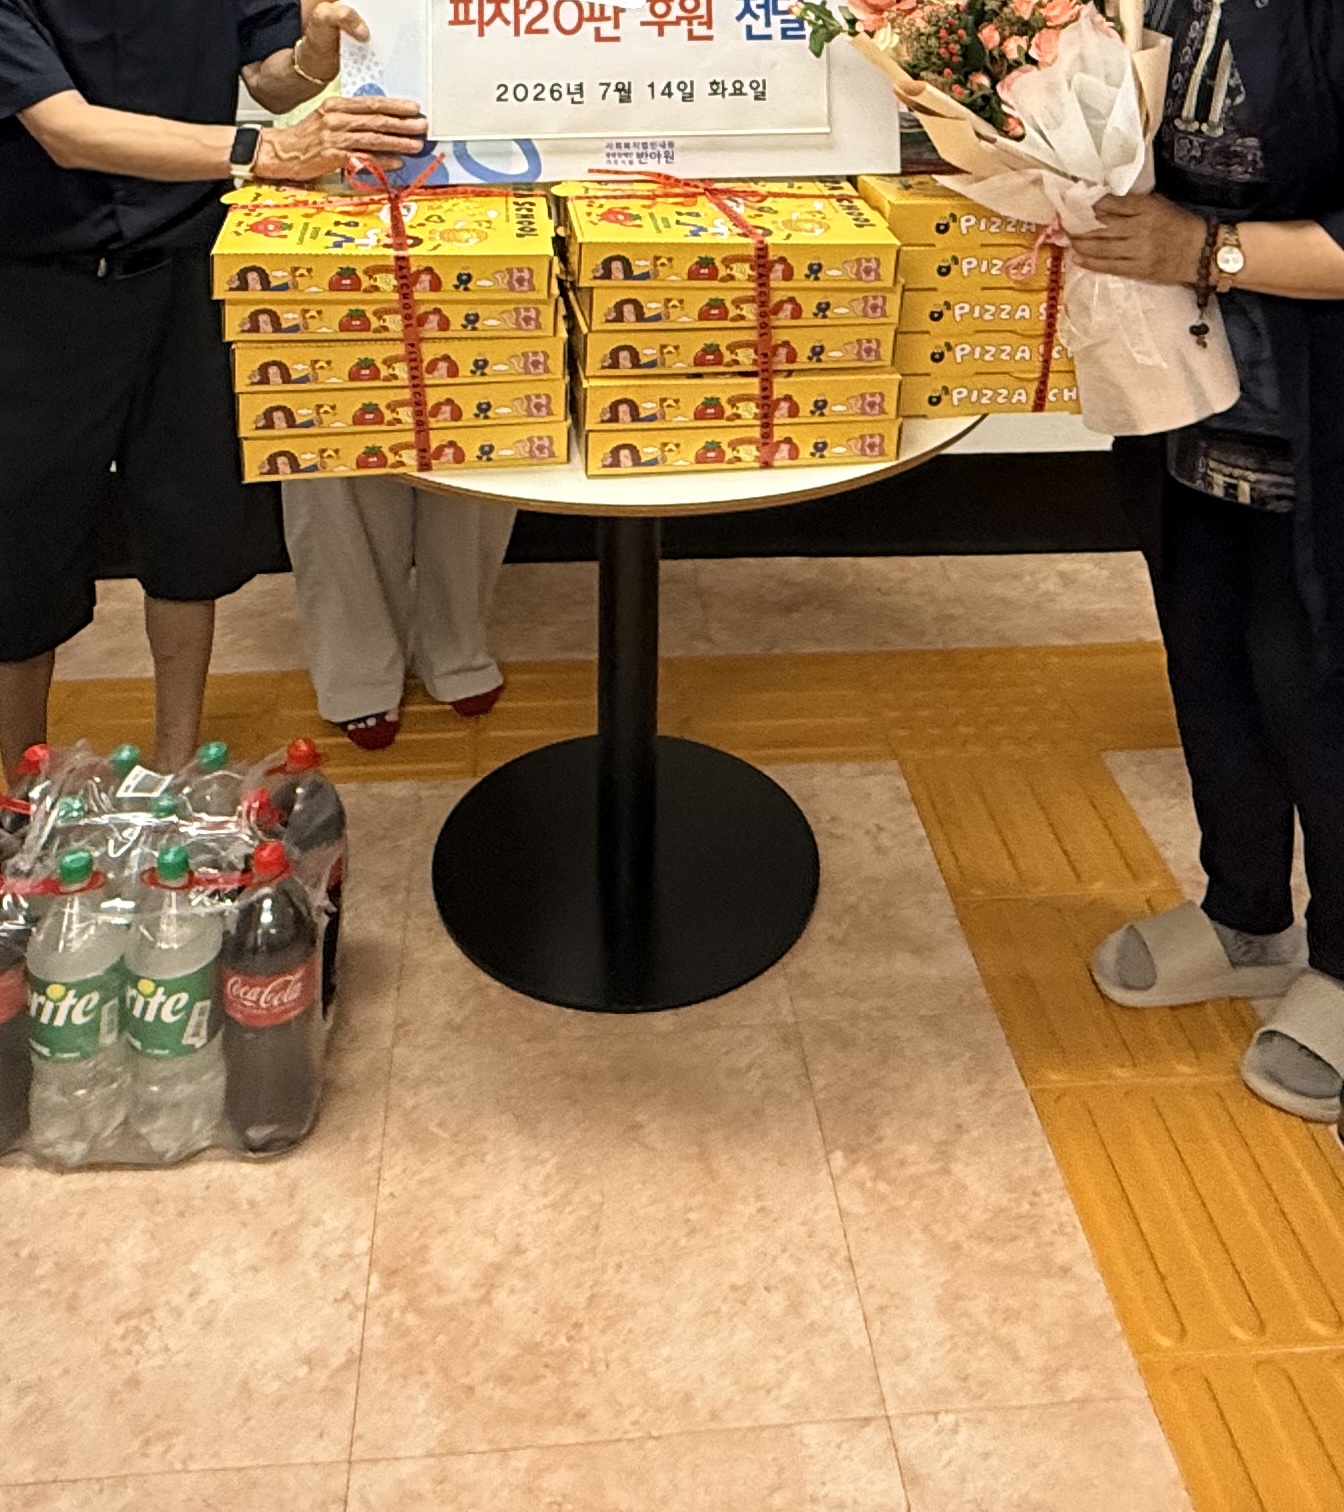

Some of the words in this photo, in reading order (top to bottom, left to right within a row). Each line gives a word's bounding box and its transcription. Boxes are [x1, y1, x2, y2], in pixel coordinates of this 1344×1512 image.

[495, 82, 586, 106] 2026년
[598, 81, 634, 103] 7월
[646, 80, 697, 103] 14일
[707, 78, 769, 101] 화요일
[636, 150, 674, 164] 반야원
[960, 214, 1037, 235] PIZZA
[954, 303, 1031, 322] PIZZA
[955, 344, 1031, 363] PIZZA
[952, 387, 1027, 407] PIZZA
[29, 987, 100, 1027] rite
[126, 986, 189, 1023] rite
